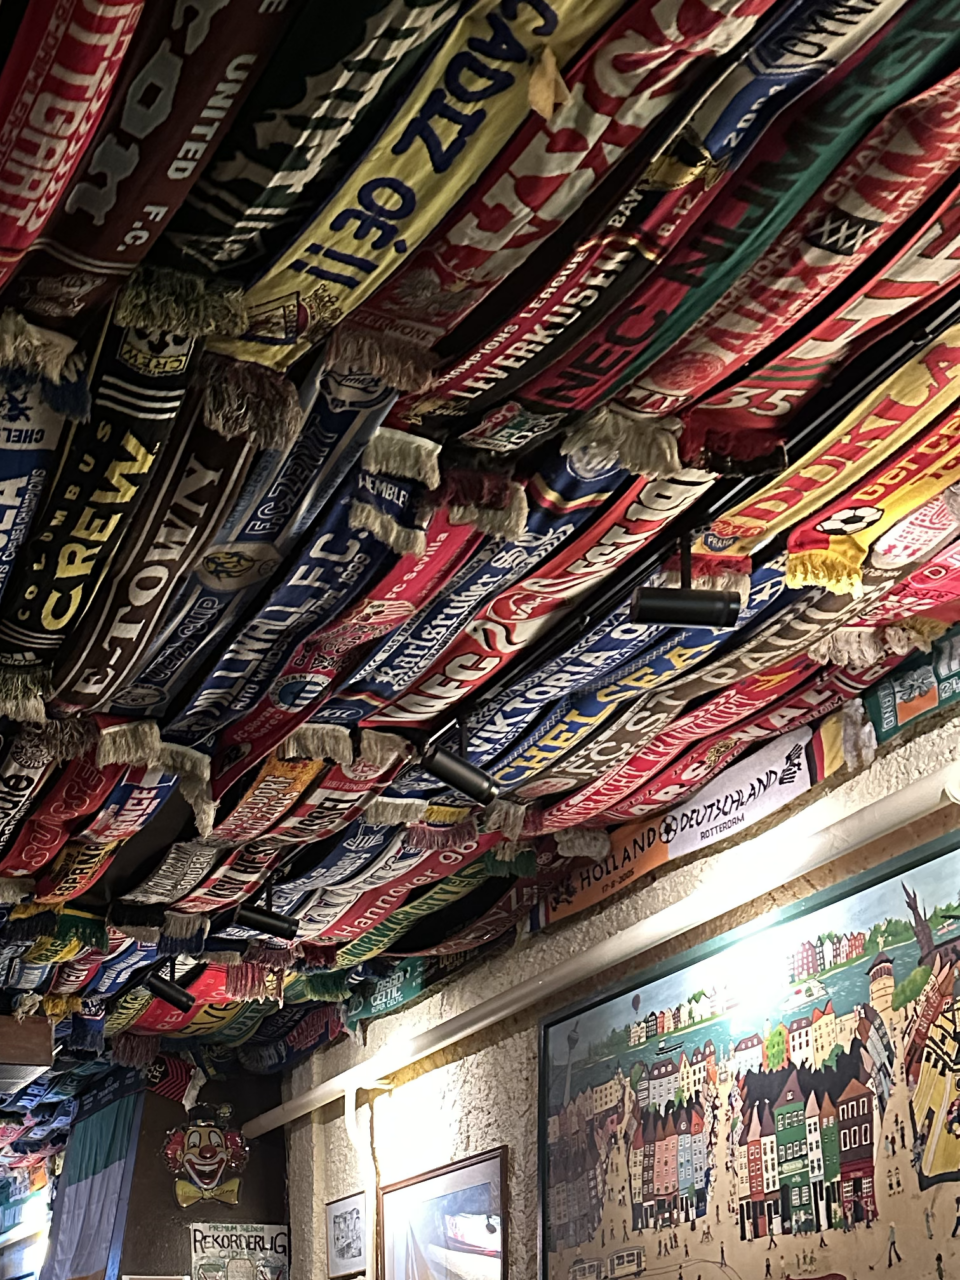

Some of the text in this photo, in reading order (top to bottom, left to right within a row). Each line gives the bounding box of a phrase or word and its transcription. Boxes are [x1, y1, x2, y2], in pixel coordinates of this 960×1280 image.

[166, 54, 258, 180] UNITED
[448, 245, 637, 400] LEVERKUSEN
[537, 303, 668, 404] NEC
[737, 343, 960, 523] DUKLA
[16, 419, 113, 622] COLUMBUS
[41, 428, 157, 631] CREW
[385, 580, 404, 600] FC
[403, 531, 450, 582] Sevilla
[707, 535, 738, 550] PRAHA
[72, 453, 224, 697] E-TOWN
[186, 602, 311, 716] MILLWALL
[287, 529, 370, 607] F.C.
[230, 682, 260, 711] AUTO
[338, 552, 369, 591] 1999
[466, 647, 607, 754] VIKTORIA
[494, 640, 717, 786] CHELSEA
[566, 742, 632, 775] FC
[626, 688, 684, 732] ST
[628, 683, 836, 819] ARSNAL
[639, 690, 756, 764] FRANKFURT
[22, 759, 105, 867] SUISSE
[98, 789, 159, 844] FRANCE
[579, 826, 657, 892] HOLLAND
[680, 770, 779, 833] DEUTSCHLAND
[700, 813, 746, 842] ROTTERDAM
[334, 868, 441, 941] Hannover
[439, 840, 479, 867] 96
[344, 905, 410, 959] NORWICH
[409, 885, 461, 918] CITY
[370, 986, 402, 1007] CELTIC
[193, 1228, 288, 1257] REKORDERLIG
